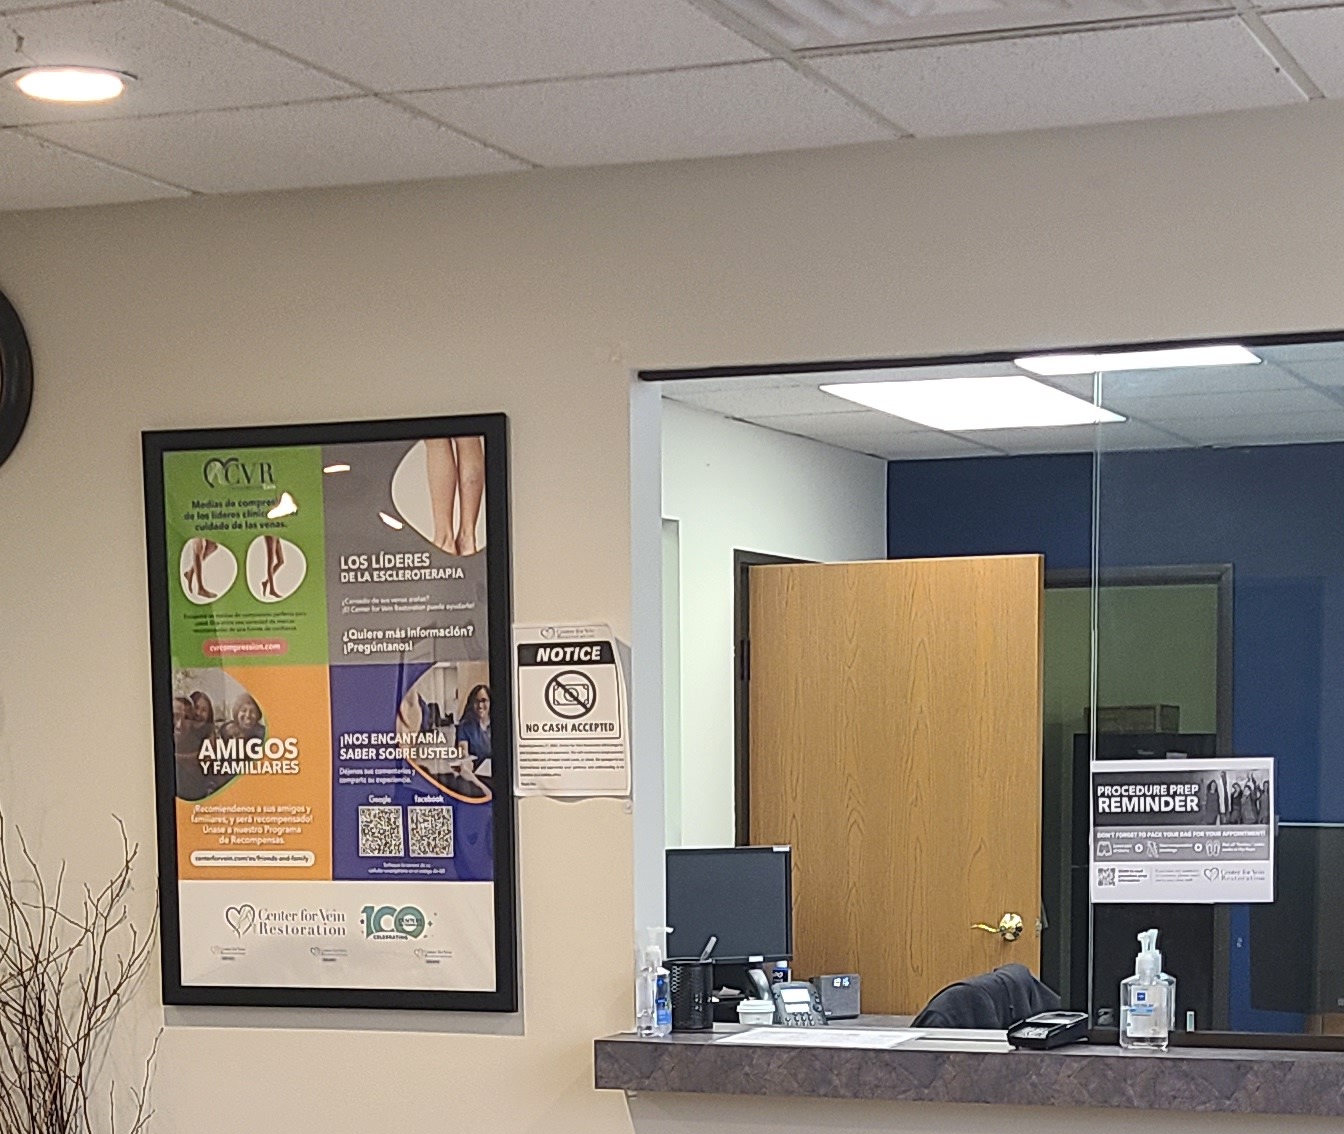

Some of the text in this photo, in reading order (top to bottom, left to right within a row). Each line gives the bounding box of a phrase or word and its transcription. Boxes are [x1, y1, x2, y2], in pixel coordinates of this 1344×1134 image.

[225, 462, 274, 484] CVR
[341, 551, 430, 569] LOS LÍDERES
[341, 568, 464, 582] DE LA ESCLEROTERAPIA
[343, 625, 474, 641] ¿Quiere más información?
[344, 640, 412, 654] ¡Pregúntanos!
[536, 646, 601, 662] NOTICE
[526, 723, 614, 733] NO CASH ACCEPTED
[340, 730, 446, 747] ¡NOS ENCANTARÍA
[198, 738, 298, 760] AMIGOS
[340, 747, 462, 760] SABER SOBRE USTED!
[200, 760, 299, 774] Y FAMILIARES
[1097, 784, 1199, 796] PROCEDURE PREP
[1098, 796, 1199, 813] REMINDER
[258, 907, 346, 922] Center for Vein
[258, 922, 346, 936] Restoration
